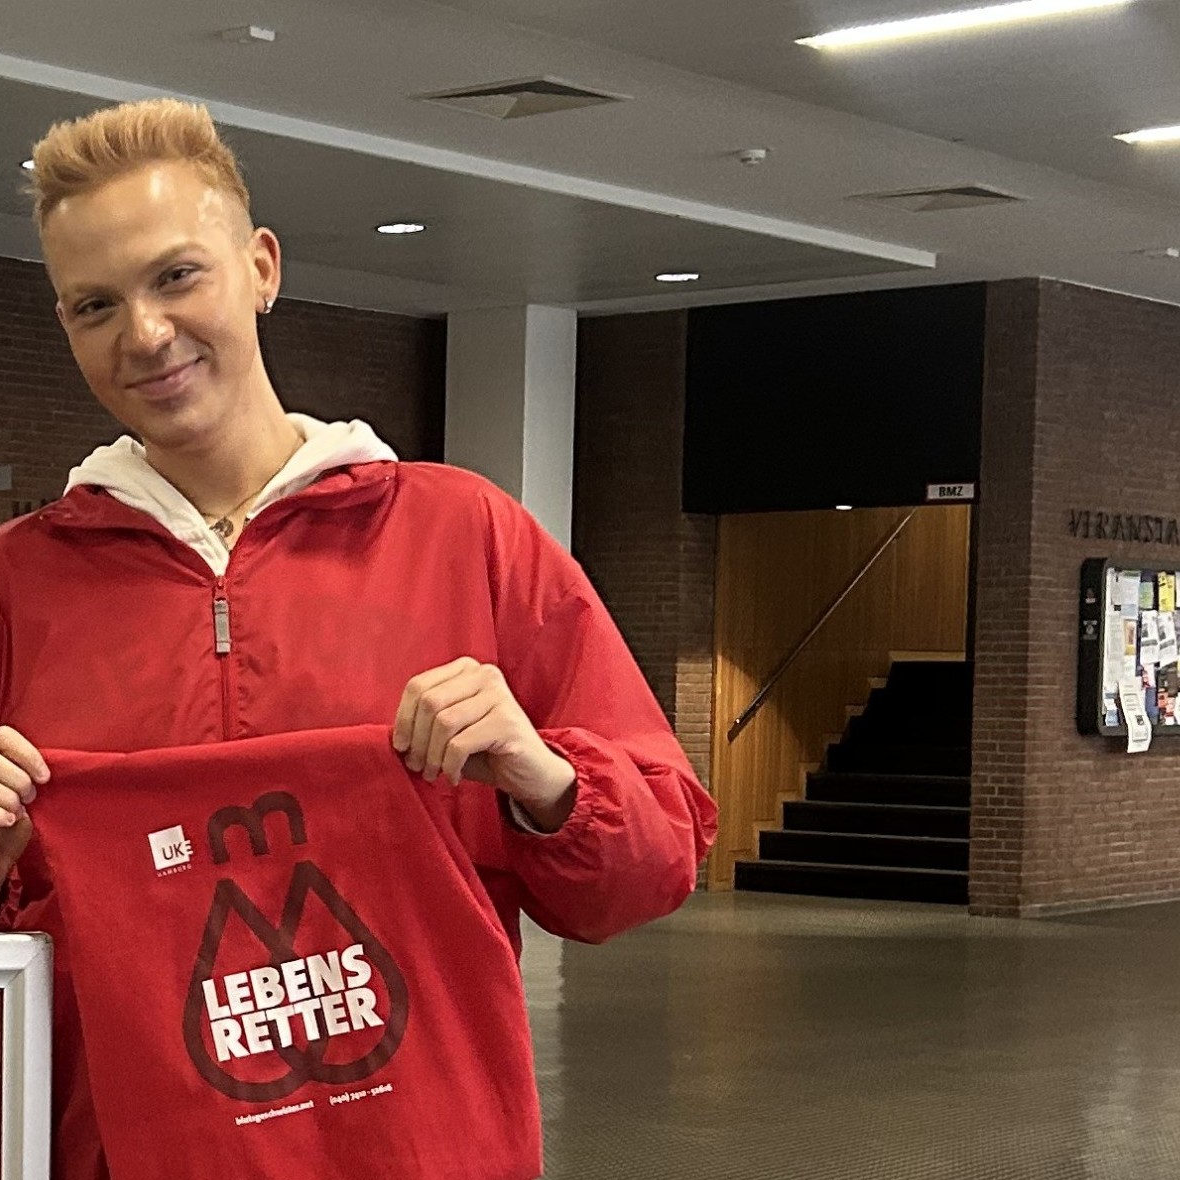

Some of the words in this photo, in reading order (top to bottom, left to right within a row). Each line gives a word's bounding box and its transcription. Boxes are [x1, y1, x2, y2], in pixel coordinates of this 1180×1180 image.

[939, 486, 963, 497] BMZ
[162, 840, 193, 860] UKE
[202, 944, 372, 1021] LEBENS
[210, 987, 385, 1062] RETTER
